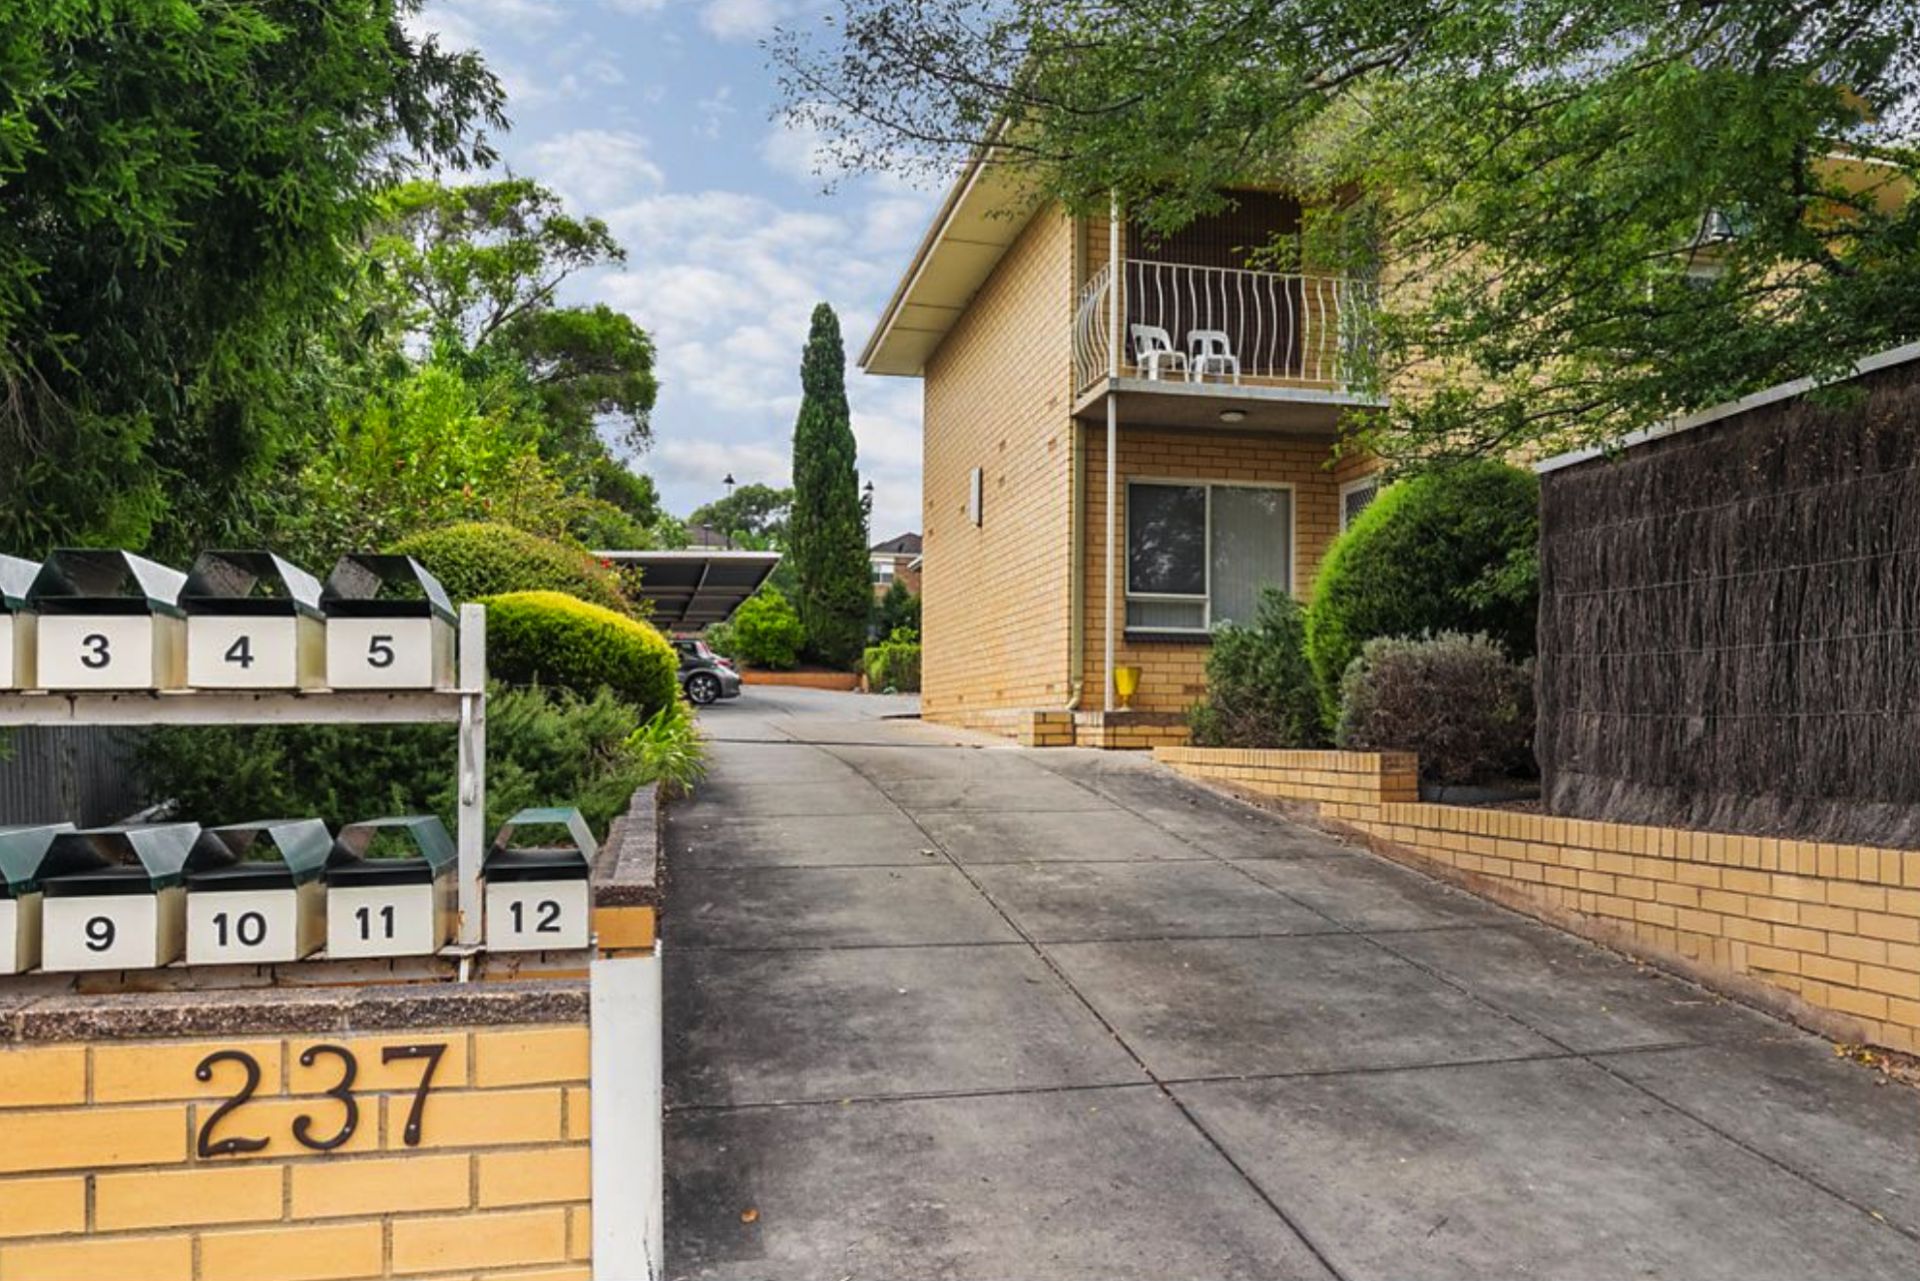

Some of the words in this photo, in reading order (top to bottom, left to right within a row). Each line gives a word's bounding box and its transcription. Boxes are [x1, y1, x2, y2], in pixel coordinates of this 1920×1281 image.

[82, 635, 110, 668] 3
[225, 636, 253, 668] 4
[368, 636, 394, 667] 5
[213, 912, 266, 946] 10
[356, 906, 393, 939] 11
[511, 901, 560, 933] 12
[86, 917, 115, 951] 9
[195, 1043, 448, 1158] 237
